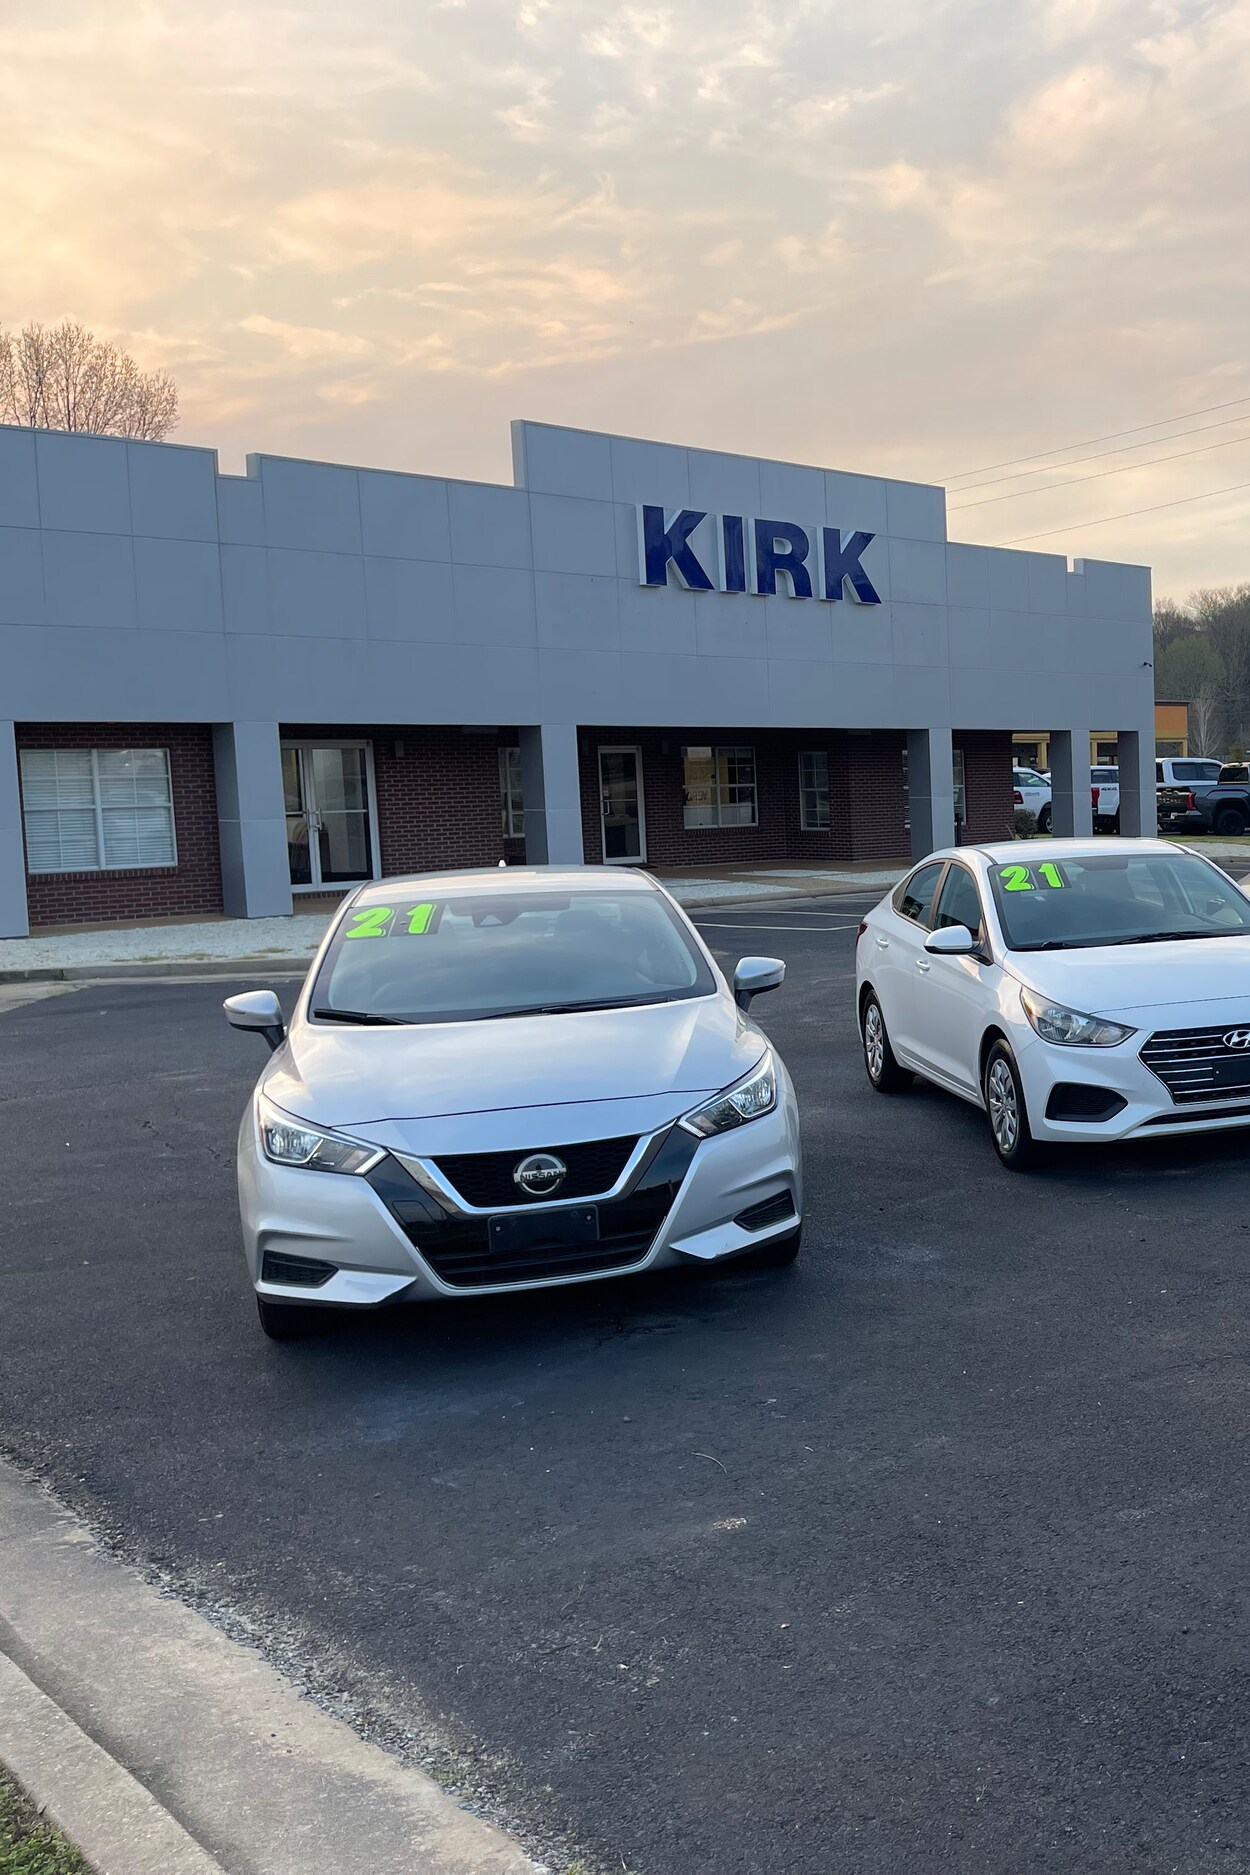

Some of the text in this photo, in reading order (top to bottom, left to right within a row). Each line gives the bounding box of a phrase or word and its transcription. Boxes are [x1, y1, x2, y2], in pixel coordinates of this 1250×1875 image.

[637, 503, 883, 605] KIRK
[1000, 863, 1065, 891] 21
[346, 903, 437, 938] 21
[520, 1170, 562, 1182] NISSAN
